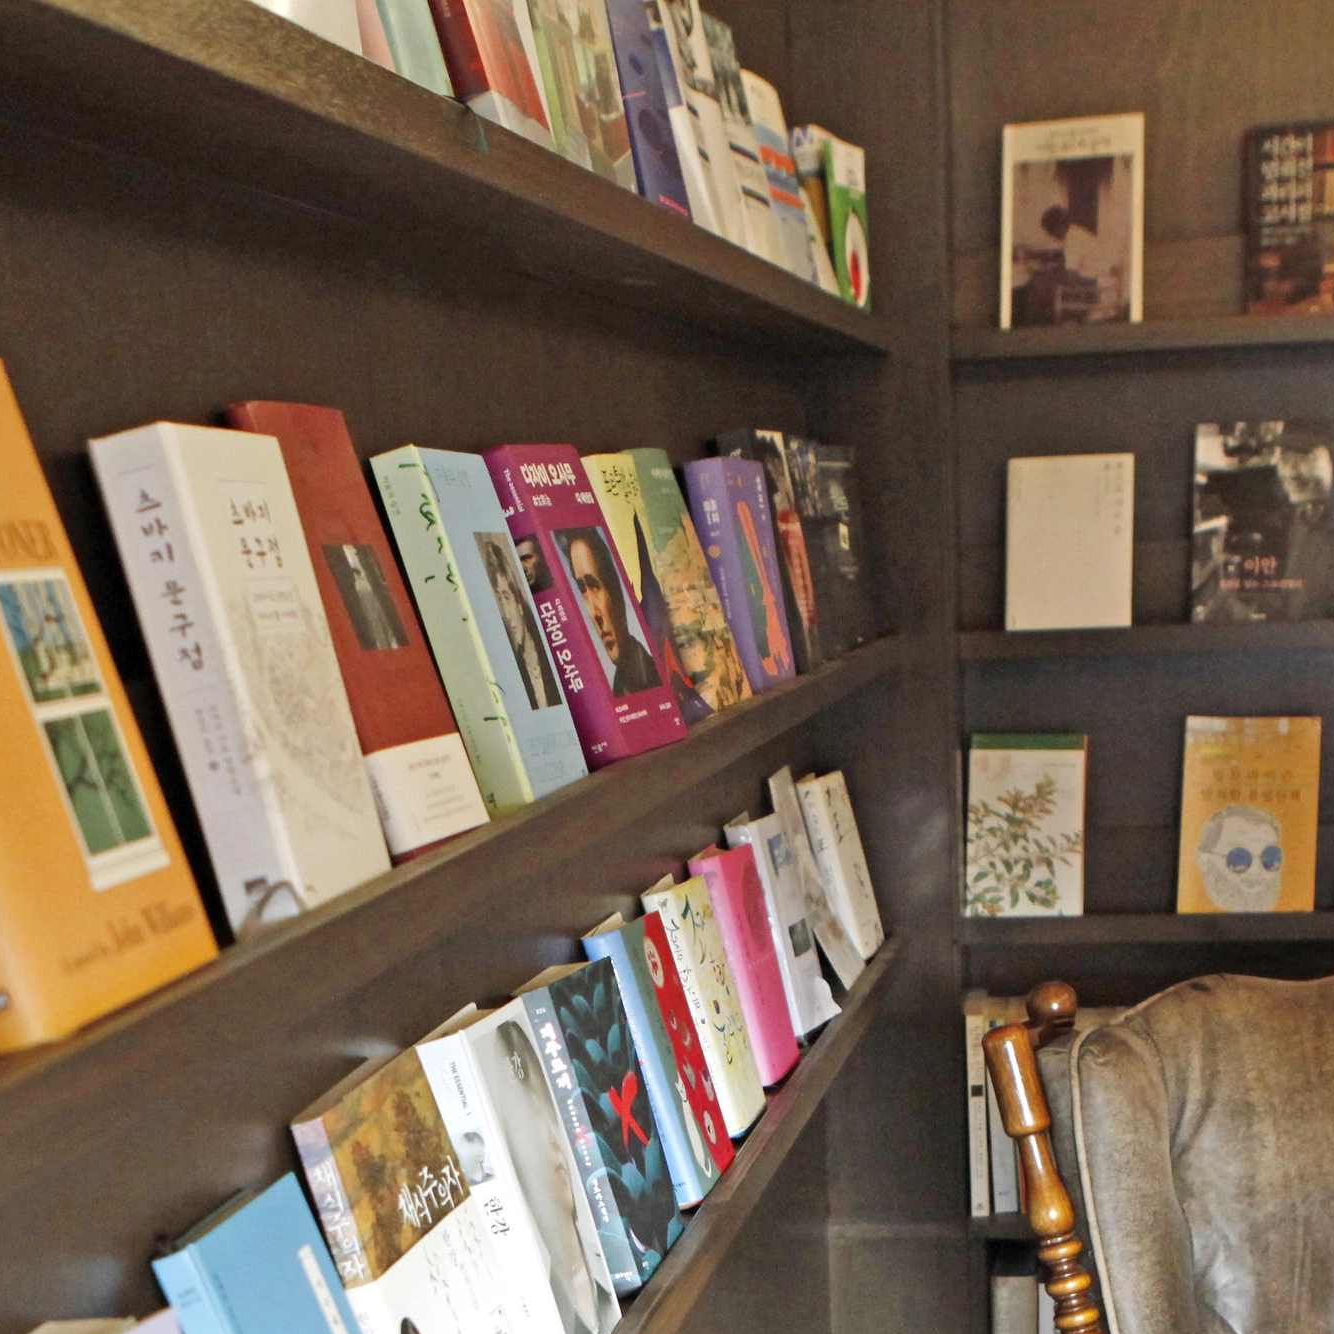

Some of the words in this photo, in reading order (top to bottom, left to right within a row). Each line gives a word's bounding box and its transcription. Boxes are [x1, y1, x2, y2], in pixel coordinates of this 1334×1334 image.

[520, 464, 552, 487] 다자이
[551, 462, 578, 486] 오사무
[502, 506, 515, 519] 3
[162, 580, 205, 671] 문구점
[539, 602, 567, 648] 다자이
[557, 649, 585, 694] 오사무
[452, 1073, 469, 1109] ESSENTIAL
[398, 1155, 465, 1229] 채식주의자
[483, 1194, 512, 1238] 한강
